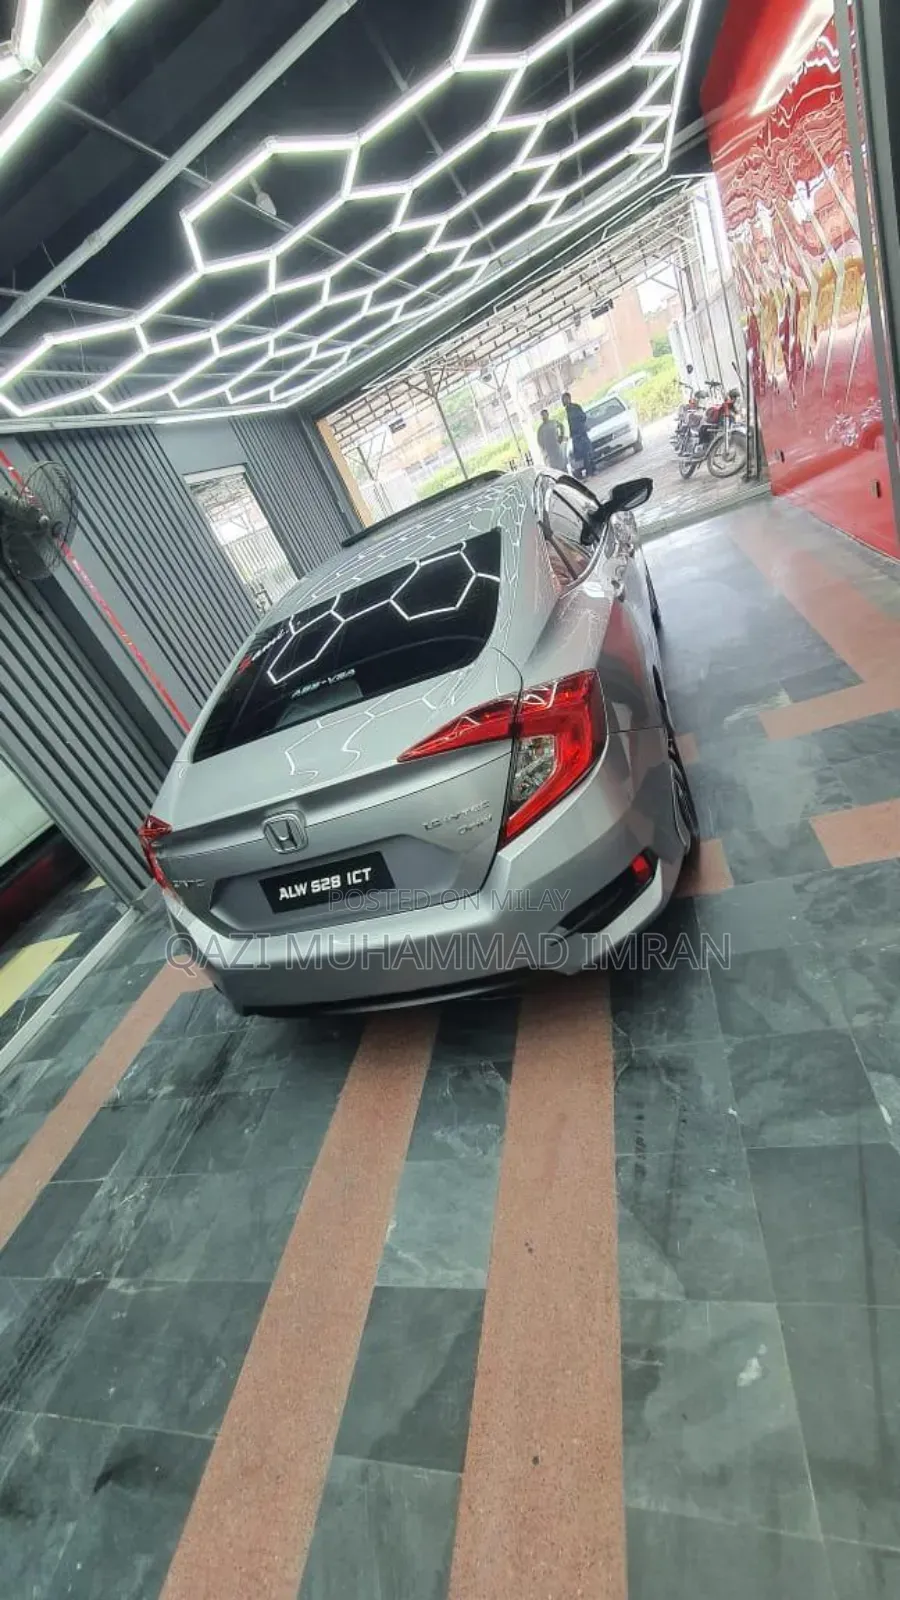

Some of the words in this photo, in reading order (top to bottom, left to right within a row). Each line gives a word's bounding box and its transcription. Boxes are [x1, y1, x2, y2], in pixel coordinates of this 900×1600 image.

[279, 881, 308, 901] ALW
[311, 874, 341, 893] 528
[346, 867, 372, 886] ICT
